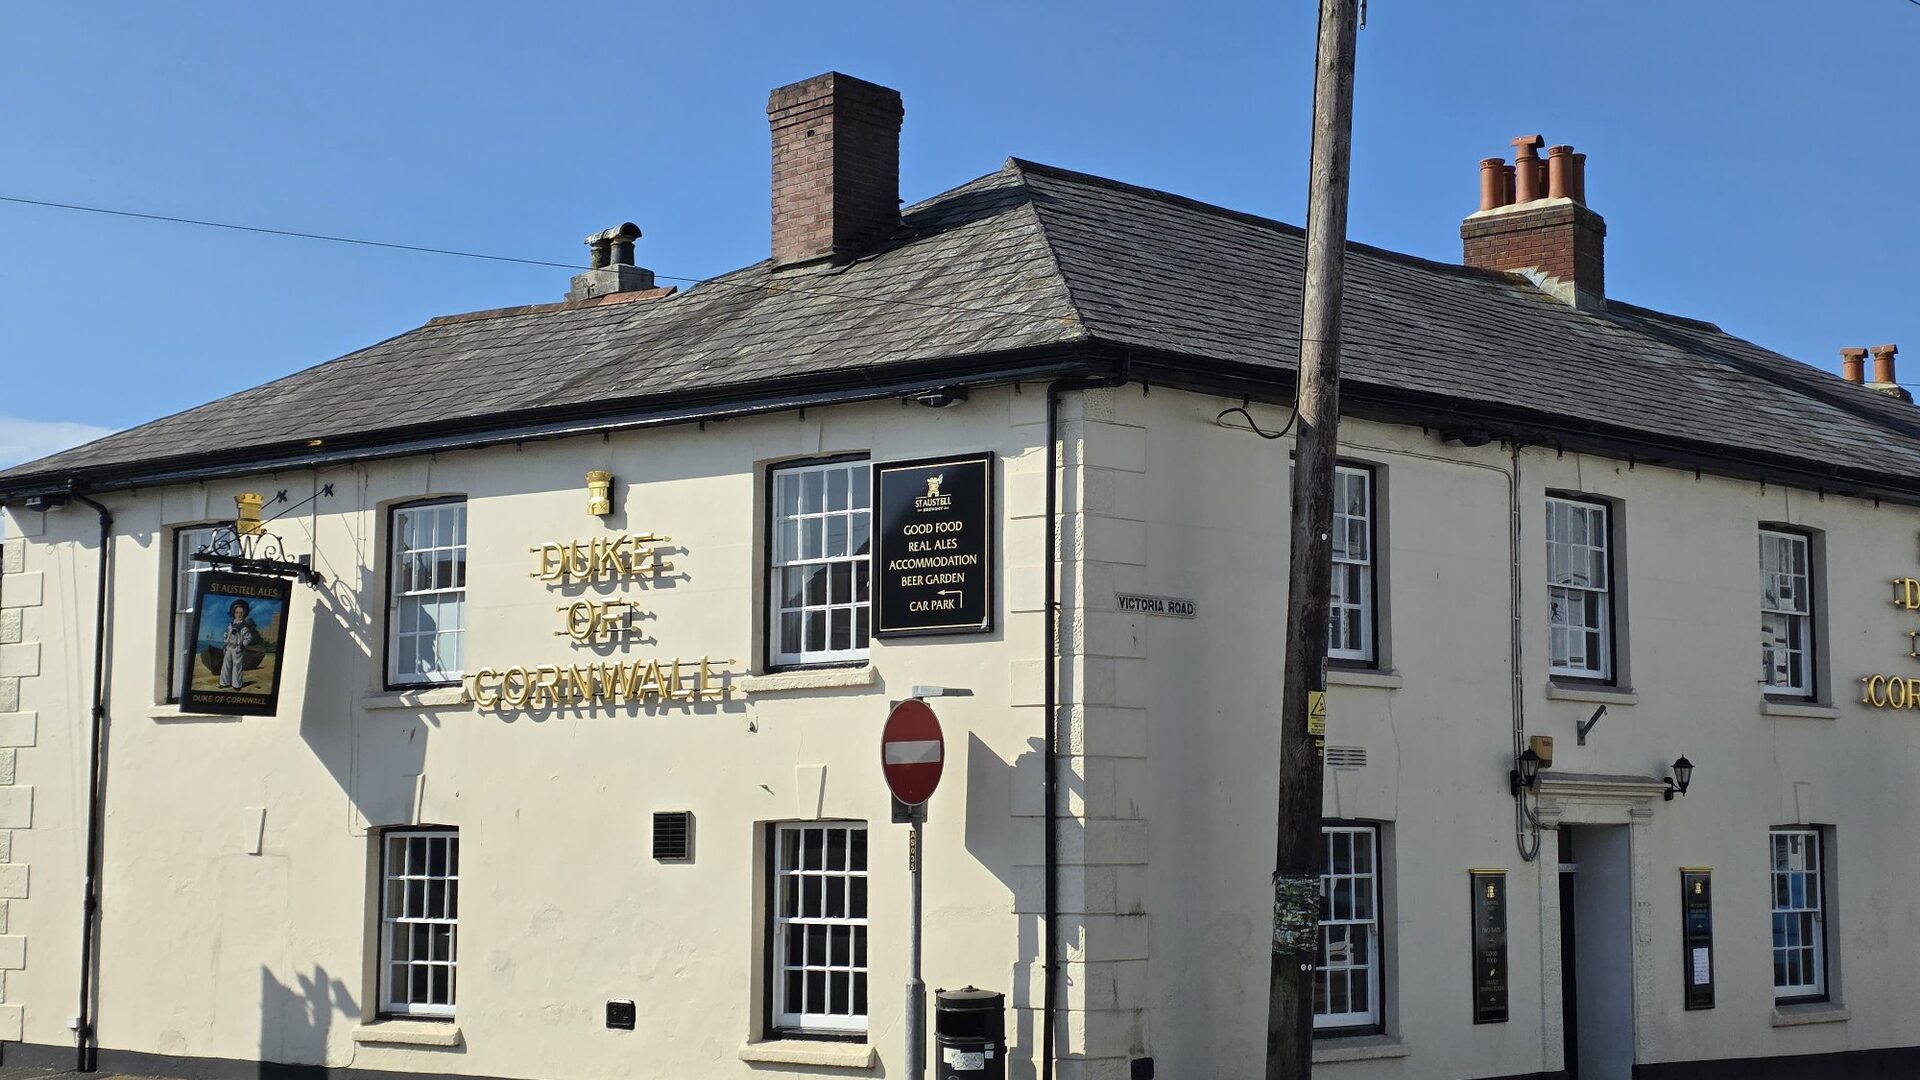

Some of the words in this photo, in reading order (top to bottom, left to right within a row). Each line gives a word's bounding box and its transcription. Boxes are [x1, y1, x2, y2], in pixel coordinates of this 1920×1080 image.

[923, 497, 951, 506] AUSTELL
[904, 523, 933, 535] GOOD
[936, 521, 962, 533] FOOD
[908, 541, 931, 552] REAL
[934, 538, 958, 550] ALES
[540, 532, 655, 581] DUKE
[889, 555, 977, 570] ACCOMMODATION
[901, 575, 923, 587] BEER
[925, 572, 965, 585] GARDEN
[221, 584, 255, 596] AUSTELL
[257, 587, 278, 598] ALES
[909, 600, 929, 612] CAR
[931, 599, 955, 611] PARK
[1119, 596, 1164, 612] VICTORIA
[1168, 601, 1194, 615] ROAD
[566, 597, 622, 640] OF
[472, 656, 723, 707] CORNWALL
[192, 694, 213, 703] DUKE
[214, 695, 225, 703] OF
[226, 696, 267, 705] CORNWALL
